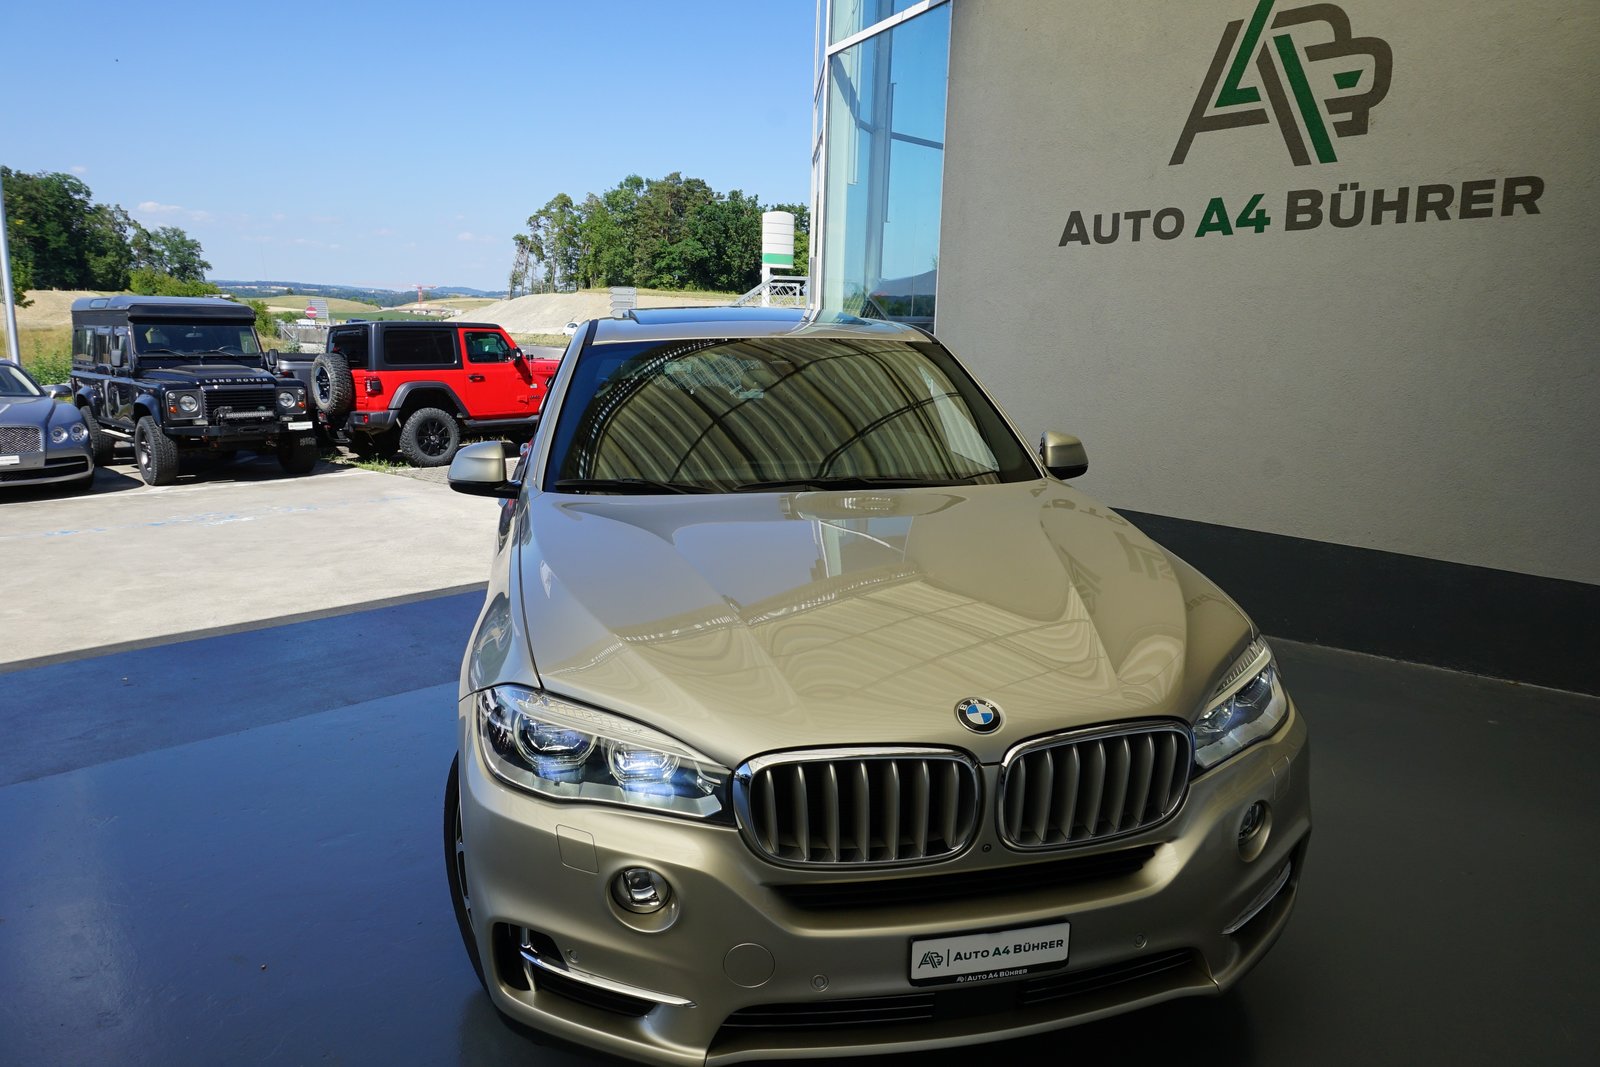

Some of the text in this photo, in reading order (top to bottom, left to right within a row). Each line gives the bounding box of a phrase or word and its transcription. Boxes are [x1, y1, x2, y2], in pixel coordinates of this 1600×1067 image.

[1058, 176, 1545, 247] AUTO A4 BÜHRER
[960, 699, 993, 710] BMW
[953, 939, 1064, 962] AUTO A4 BÜHRER
[967, 974, 987, 982] AUTO
